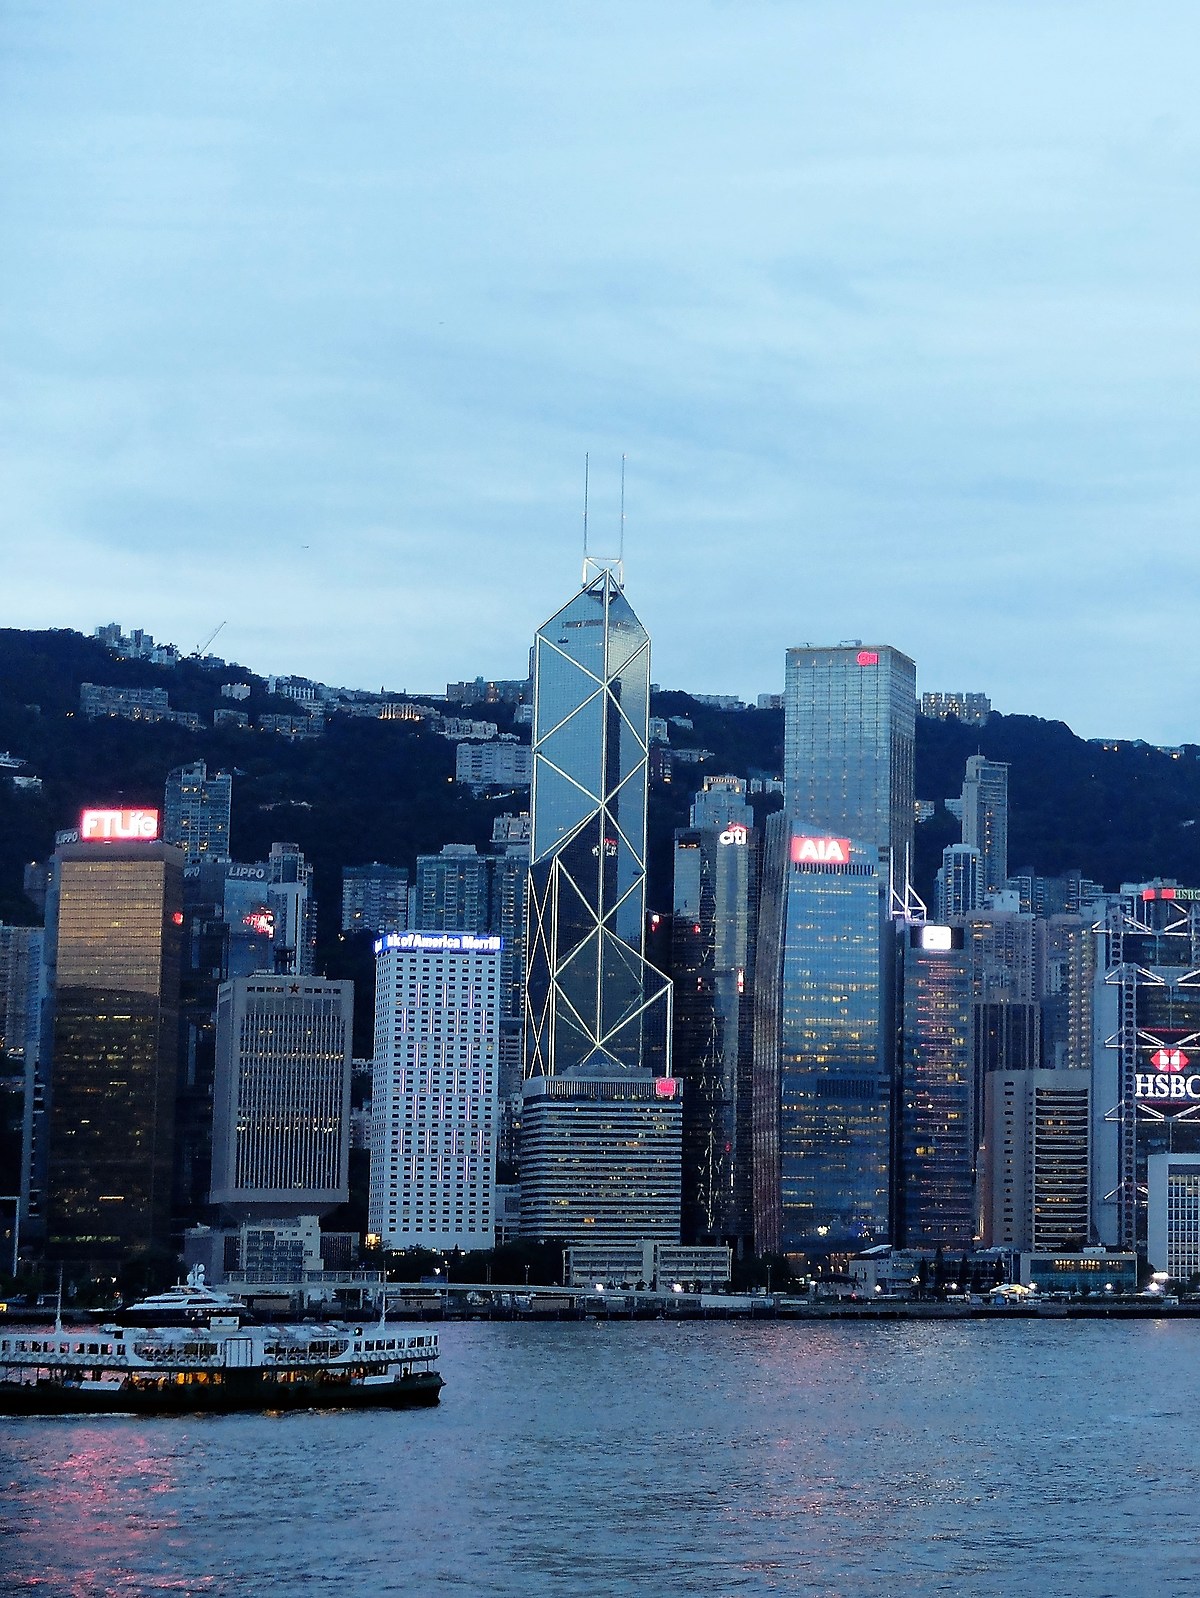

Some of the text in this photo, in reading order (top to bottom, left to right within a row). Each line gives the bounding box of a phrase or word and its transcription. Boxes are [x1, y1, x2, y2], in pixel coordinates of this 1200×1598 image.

[83, 811, 158, 837] FTLife
[799, 840, 844, 860] AIA
[228, 867, 265, 879] LIPPO
[413, 933, 460, 948] America
